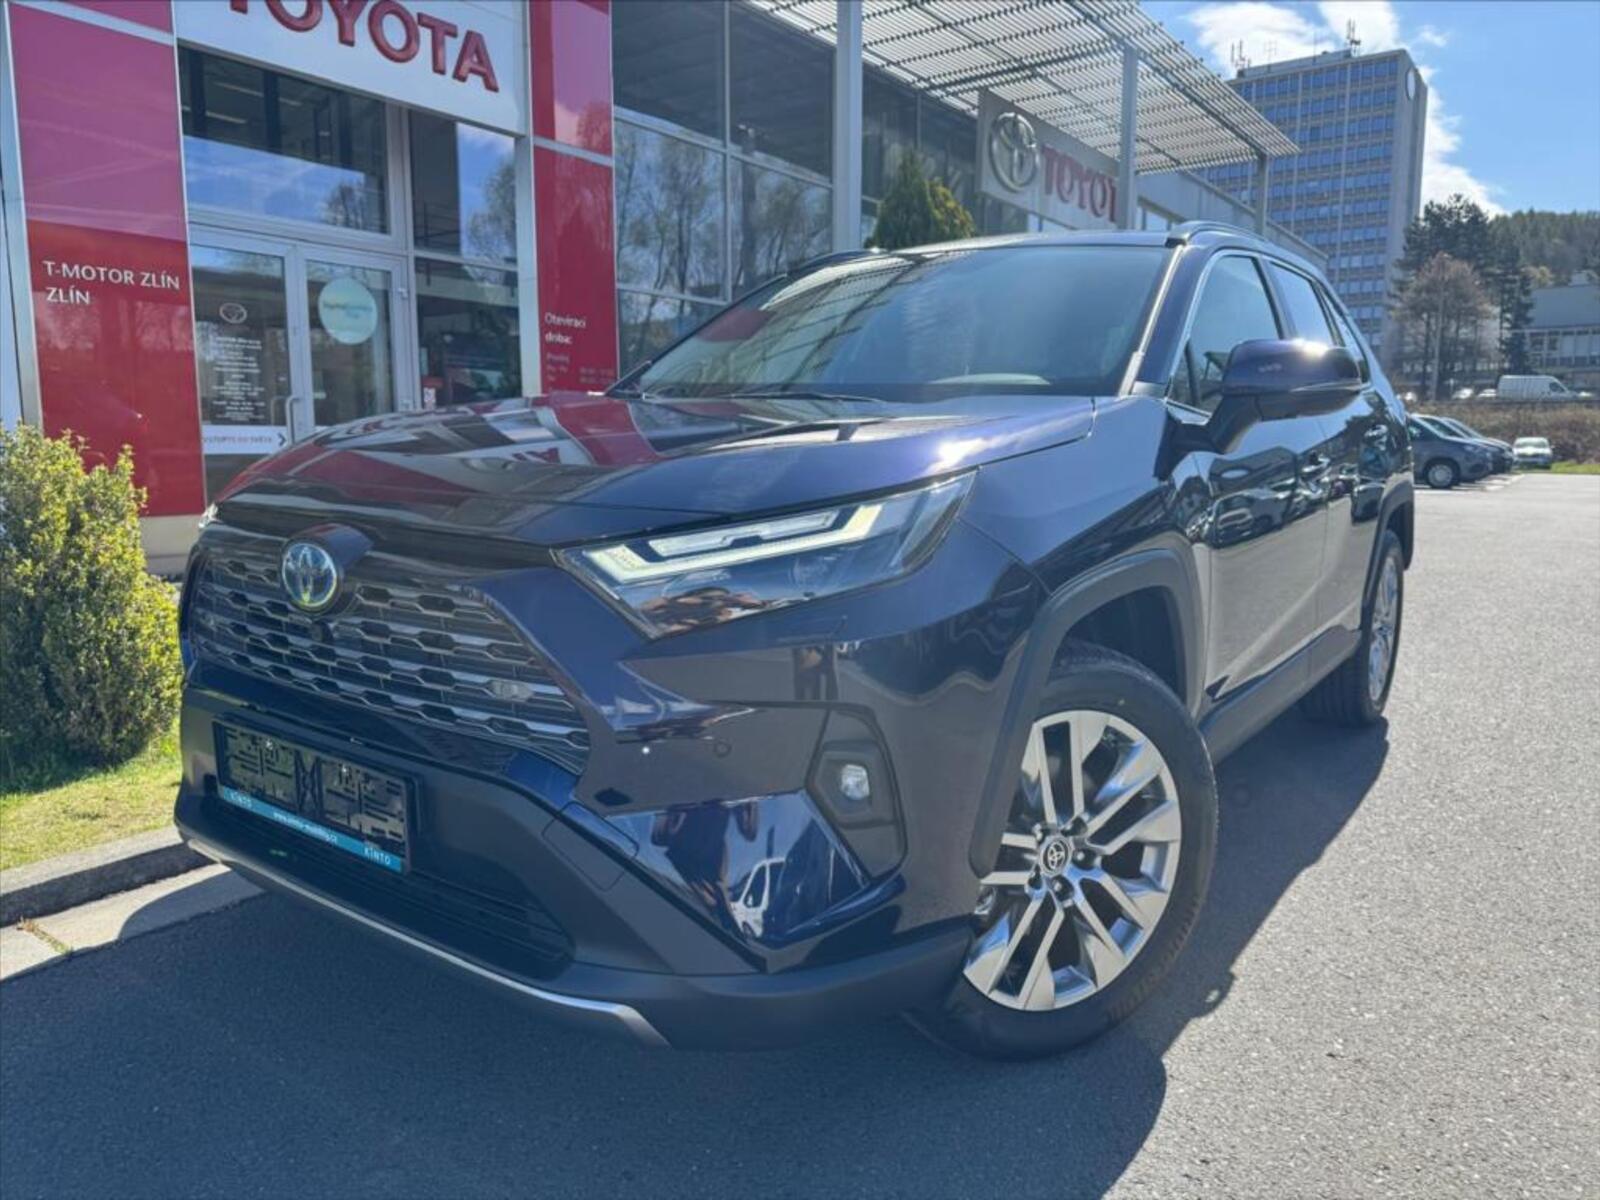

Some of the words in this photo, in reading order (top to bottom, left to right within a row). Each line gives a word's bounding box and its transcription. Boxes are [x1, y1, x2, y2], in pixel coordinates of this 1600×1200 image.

[42, 260, 134, 285] T-MOTOR
[140, 270, 180, 290] ZLÍN
[45, 285, 91, 304] ZLÍN
